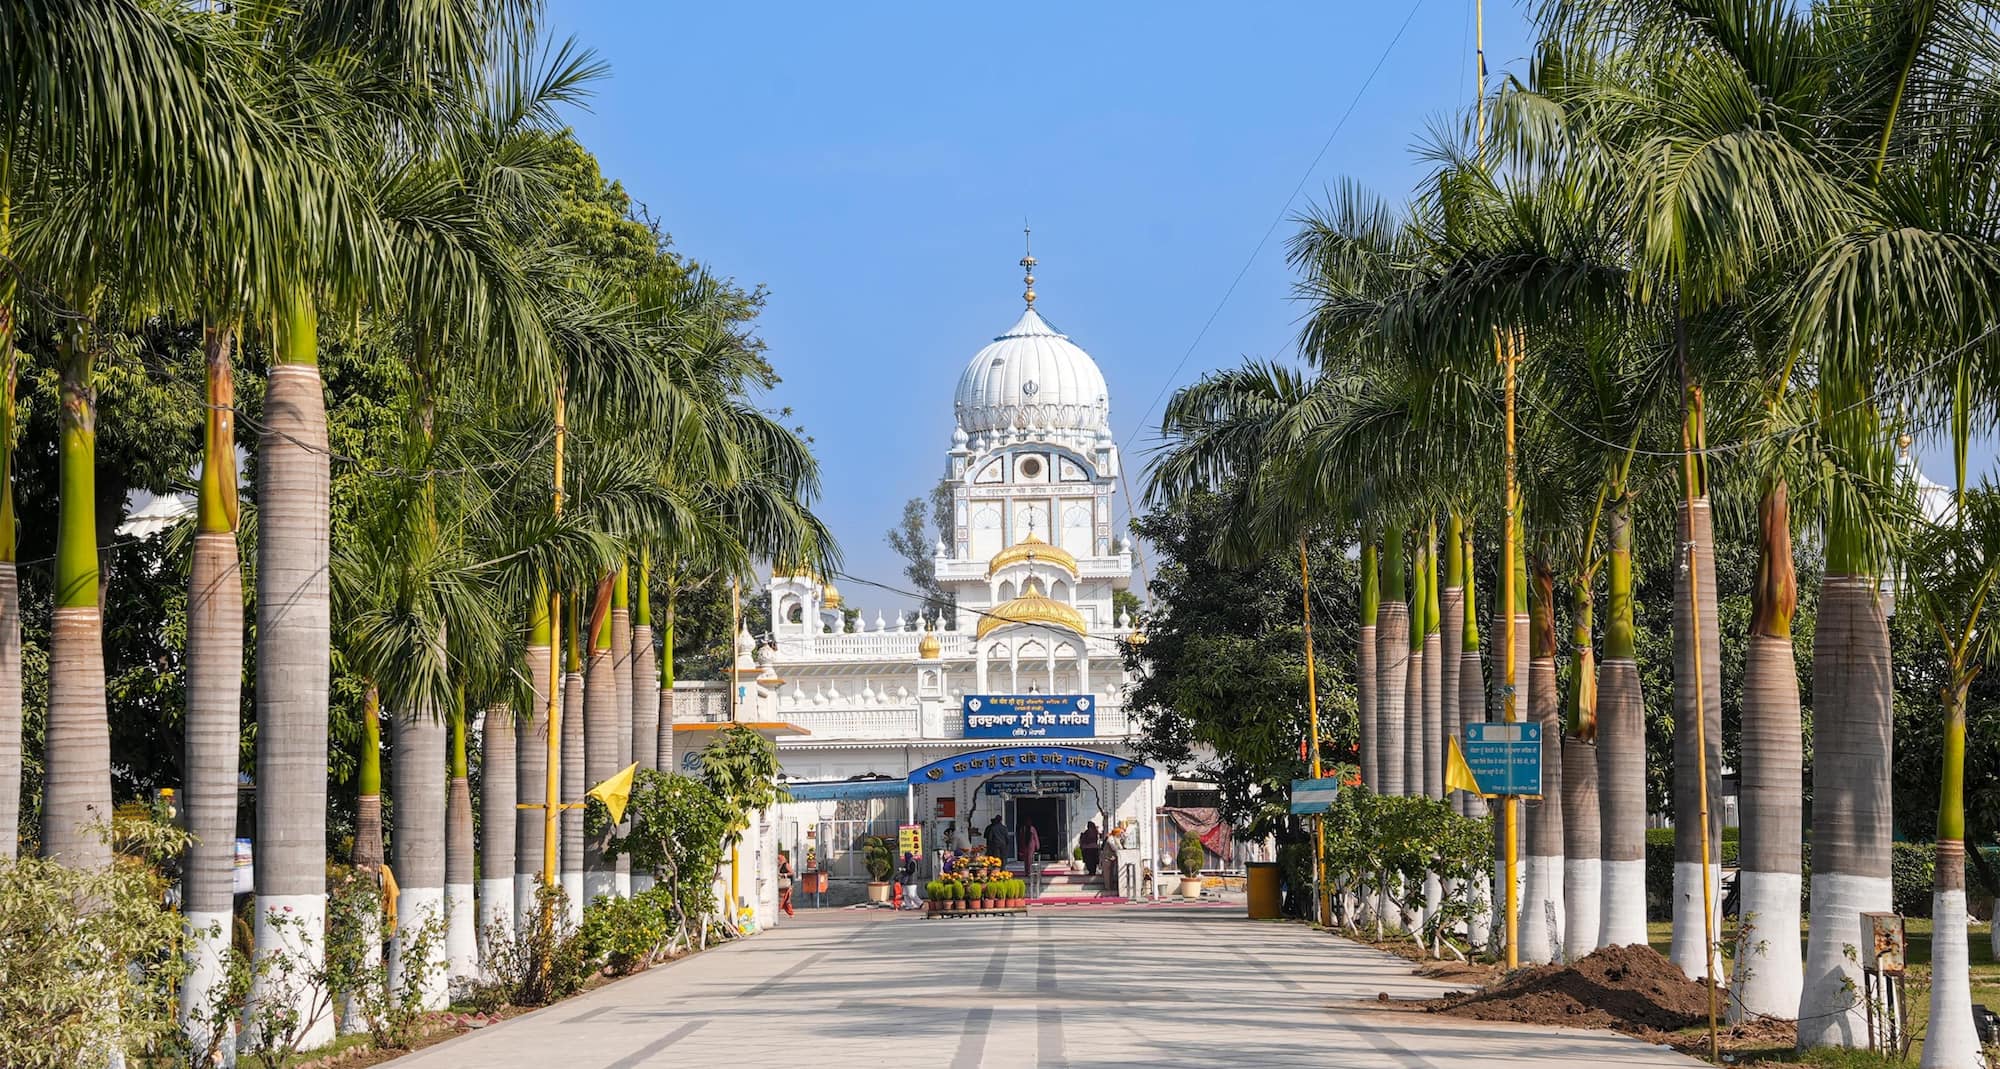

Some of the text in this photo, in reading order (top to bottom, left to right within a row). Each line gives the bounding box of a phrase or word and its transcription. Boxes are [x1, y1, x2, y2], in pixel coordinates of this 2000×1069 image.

[968, 711, 1090, 728] ਗੁਰਦੁਆਰਾ ਸ੍ਰੀ ਅੰਬ ਸਾਹਿਬ
[1066, 754, 1095, 768] ਸਾਹਿਬ
